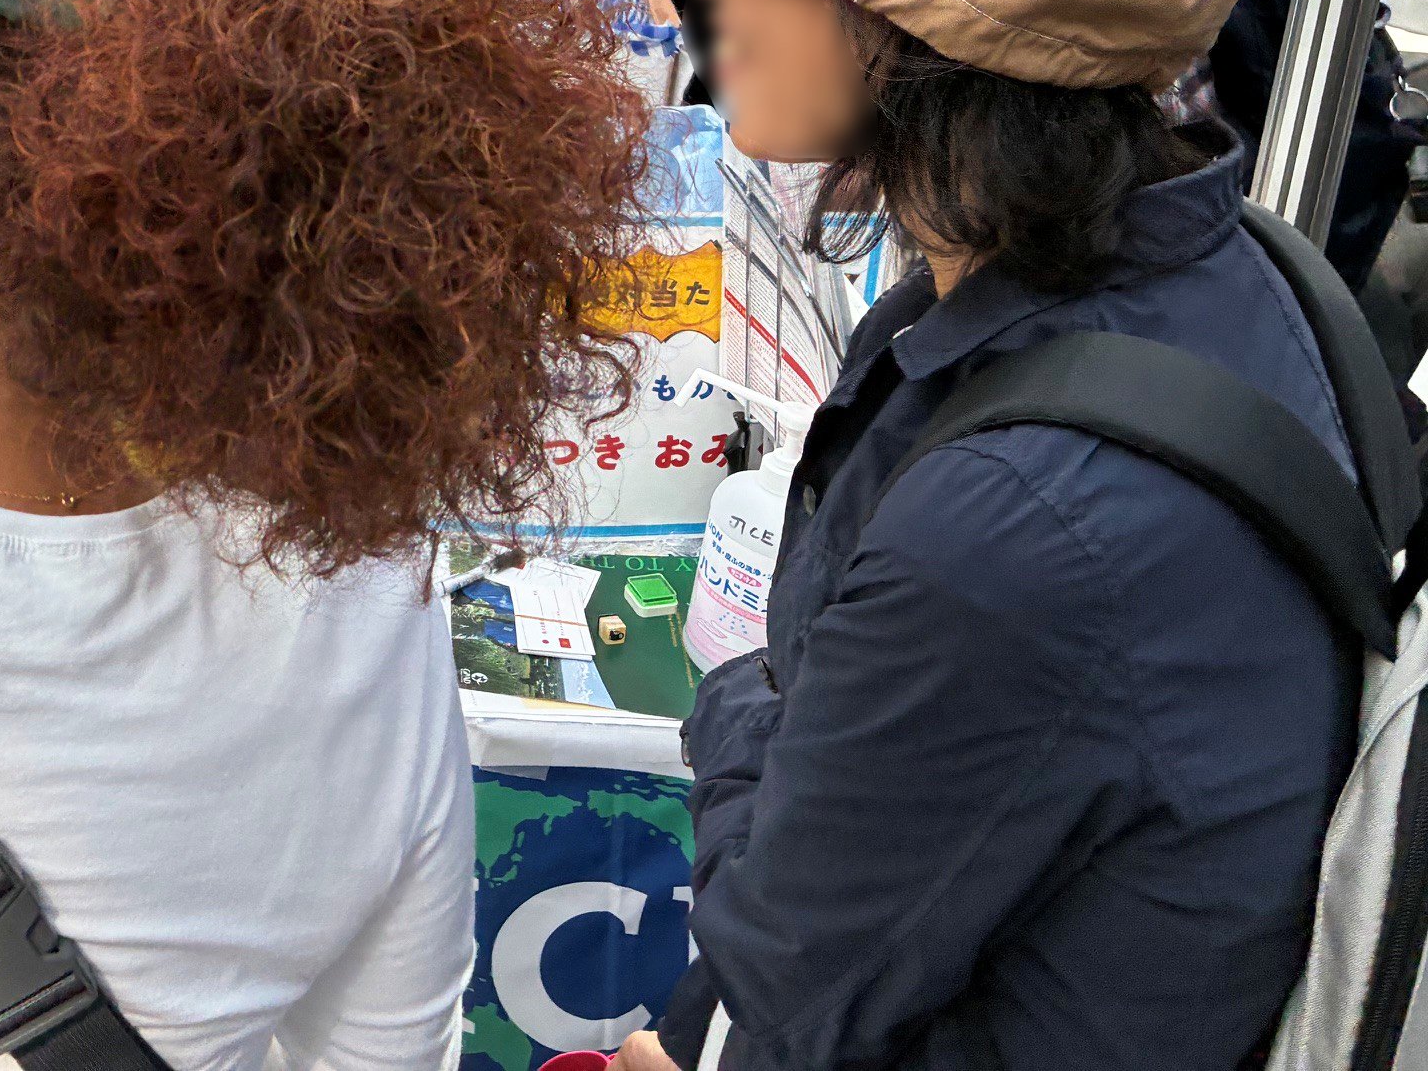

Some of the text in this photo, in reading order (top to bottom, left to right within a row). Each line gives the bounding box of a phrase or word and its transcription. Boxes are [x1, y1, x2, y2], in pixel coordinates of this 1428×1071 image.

[655, 433, 729, 470] おみ
[729, 515, 774, 547] JICE
[625, 557, 664, 571] TO
